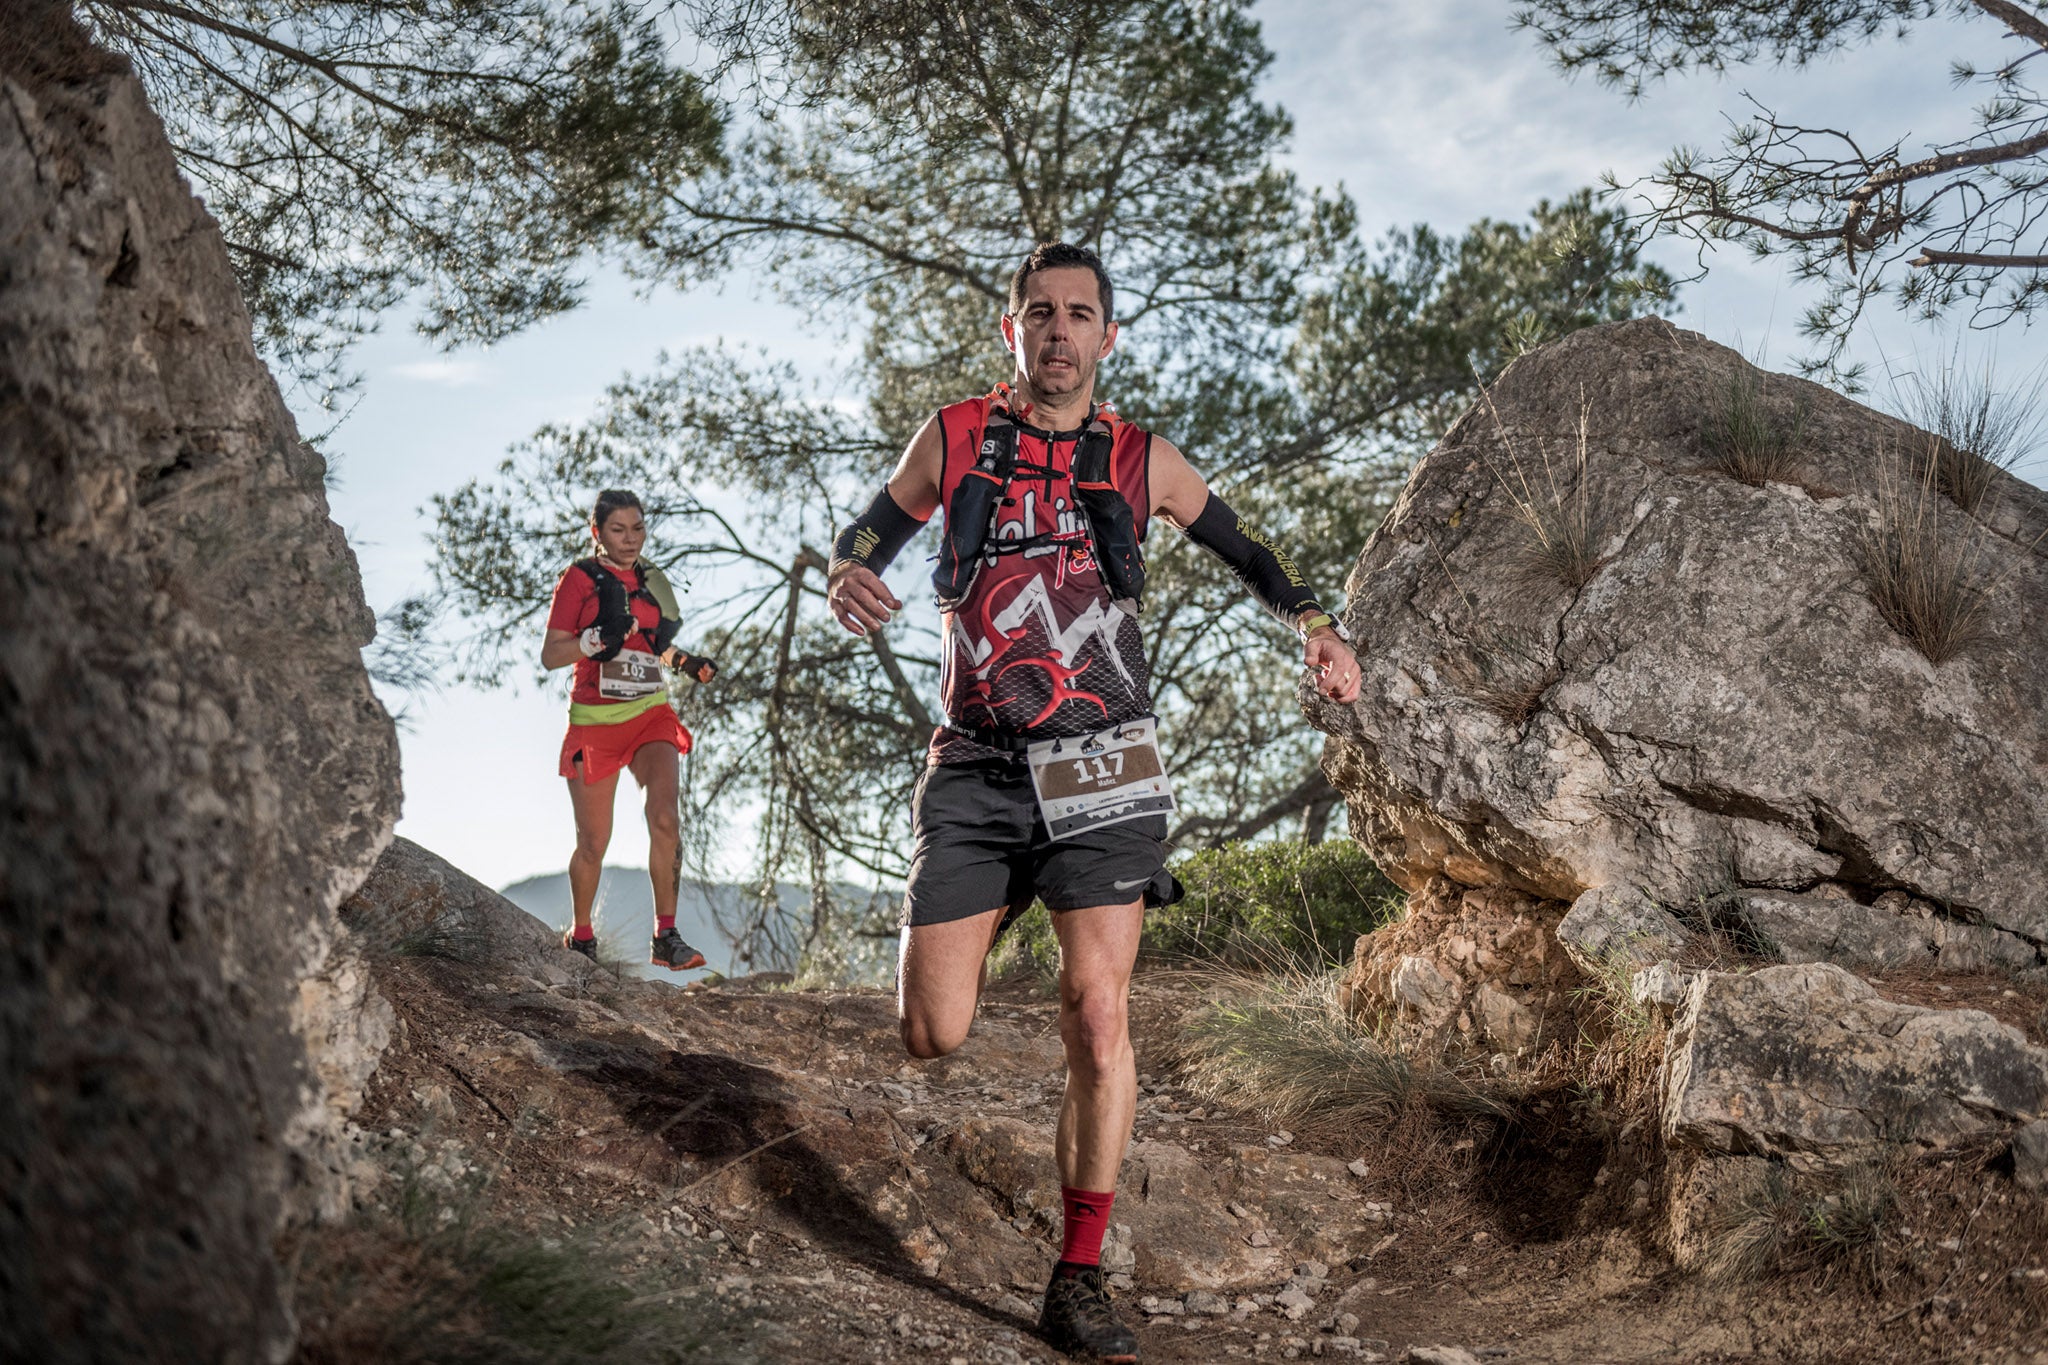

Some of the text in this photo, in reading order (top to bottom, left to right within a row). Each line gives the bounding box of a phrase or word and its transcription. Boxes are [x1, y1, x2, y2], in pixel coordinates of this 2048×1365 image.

[621, 663, 646, 679] 102
[948, 722, 977, 739] alenji
[1073, 751, 1124, 784] 117
